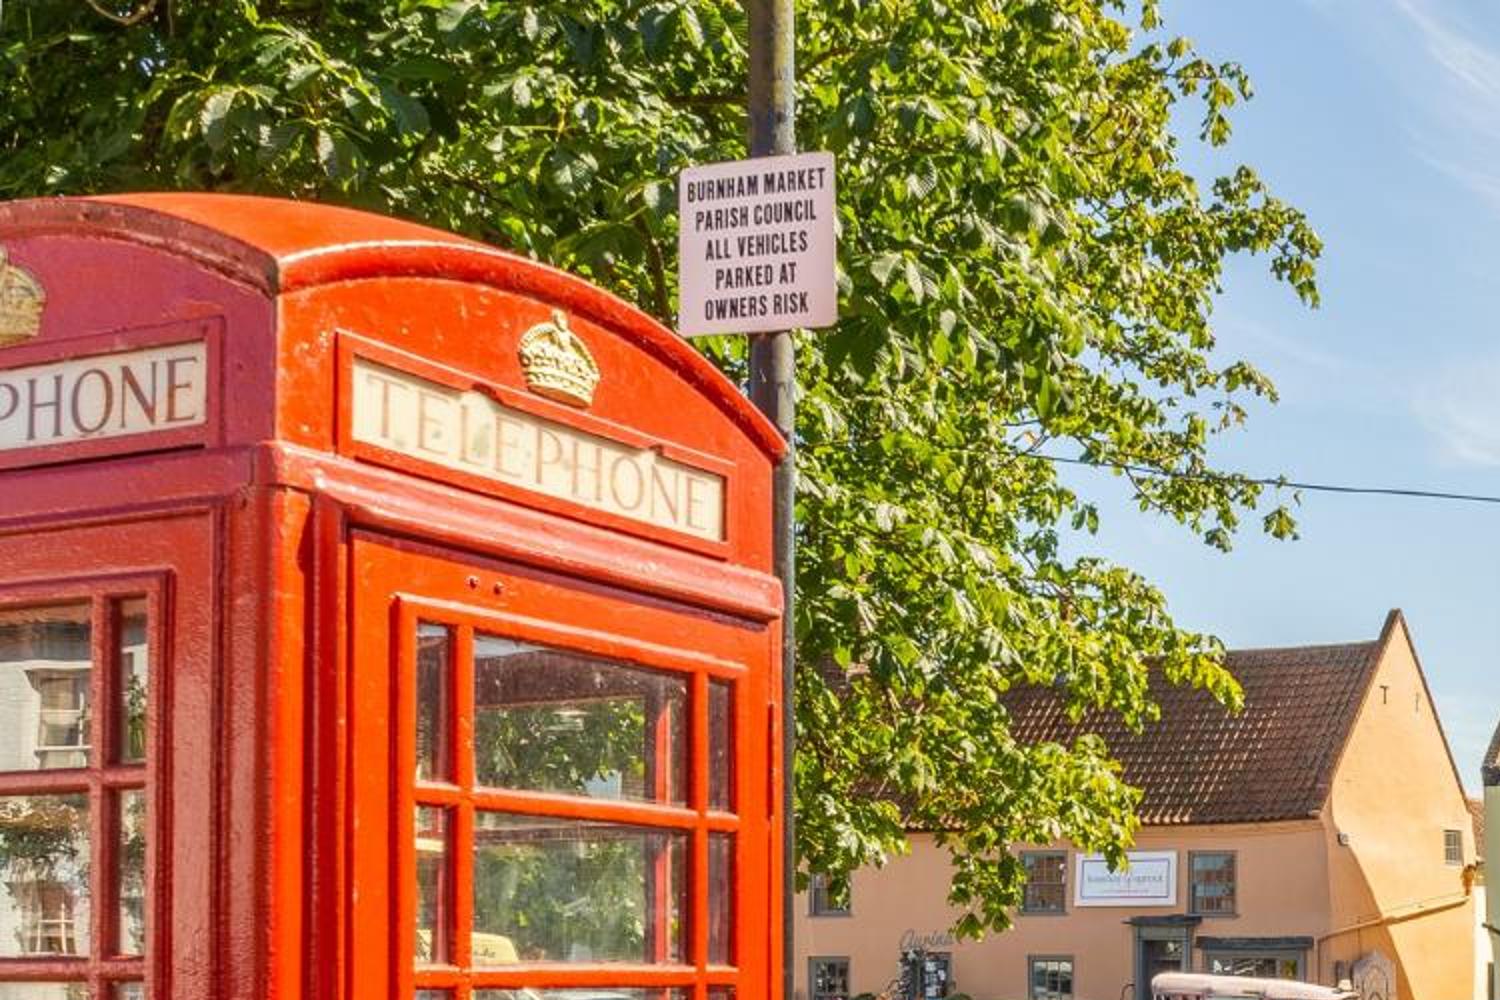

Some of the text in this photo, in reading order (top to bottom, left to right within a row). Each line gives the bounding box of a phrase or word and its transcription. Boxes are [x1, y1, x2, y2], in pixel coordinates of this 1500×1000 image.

[687, 167, 826, 203] BURNHAM MARKET
[695, 199, 816, 233] PARISH COUNCIL
[705, 230, 809, 261] ALL VEHICLES
[715, 262, 797, 290] PARKED AT
[704, 291, 809, 321] OWNERS RISK
[366, 373, 711, 532] TELEPHONE
